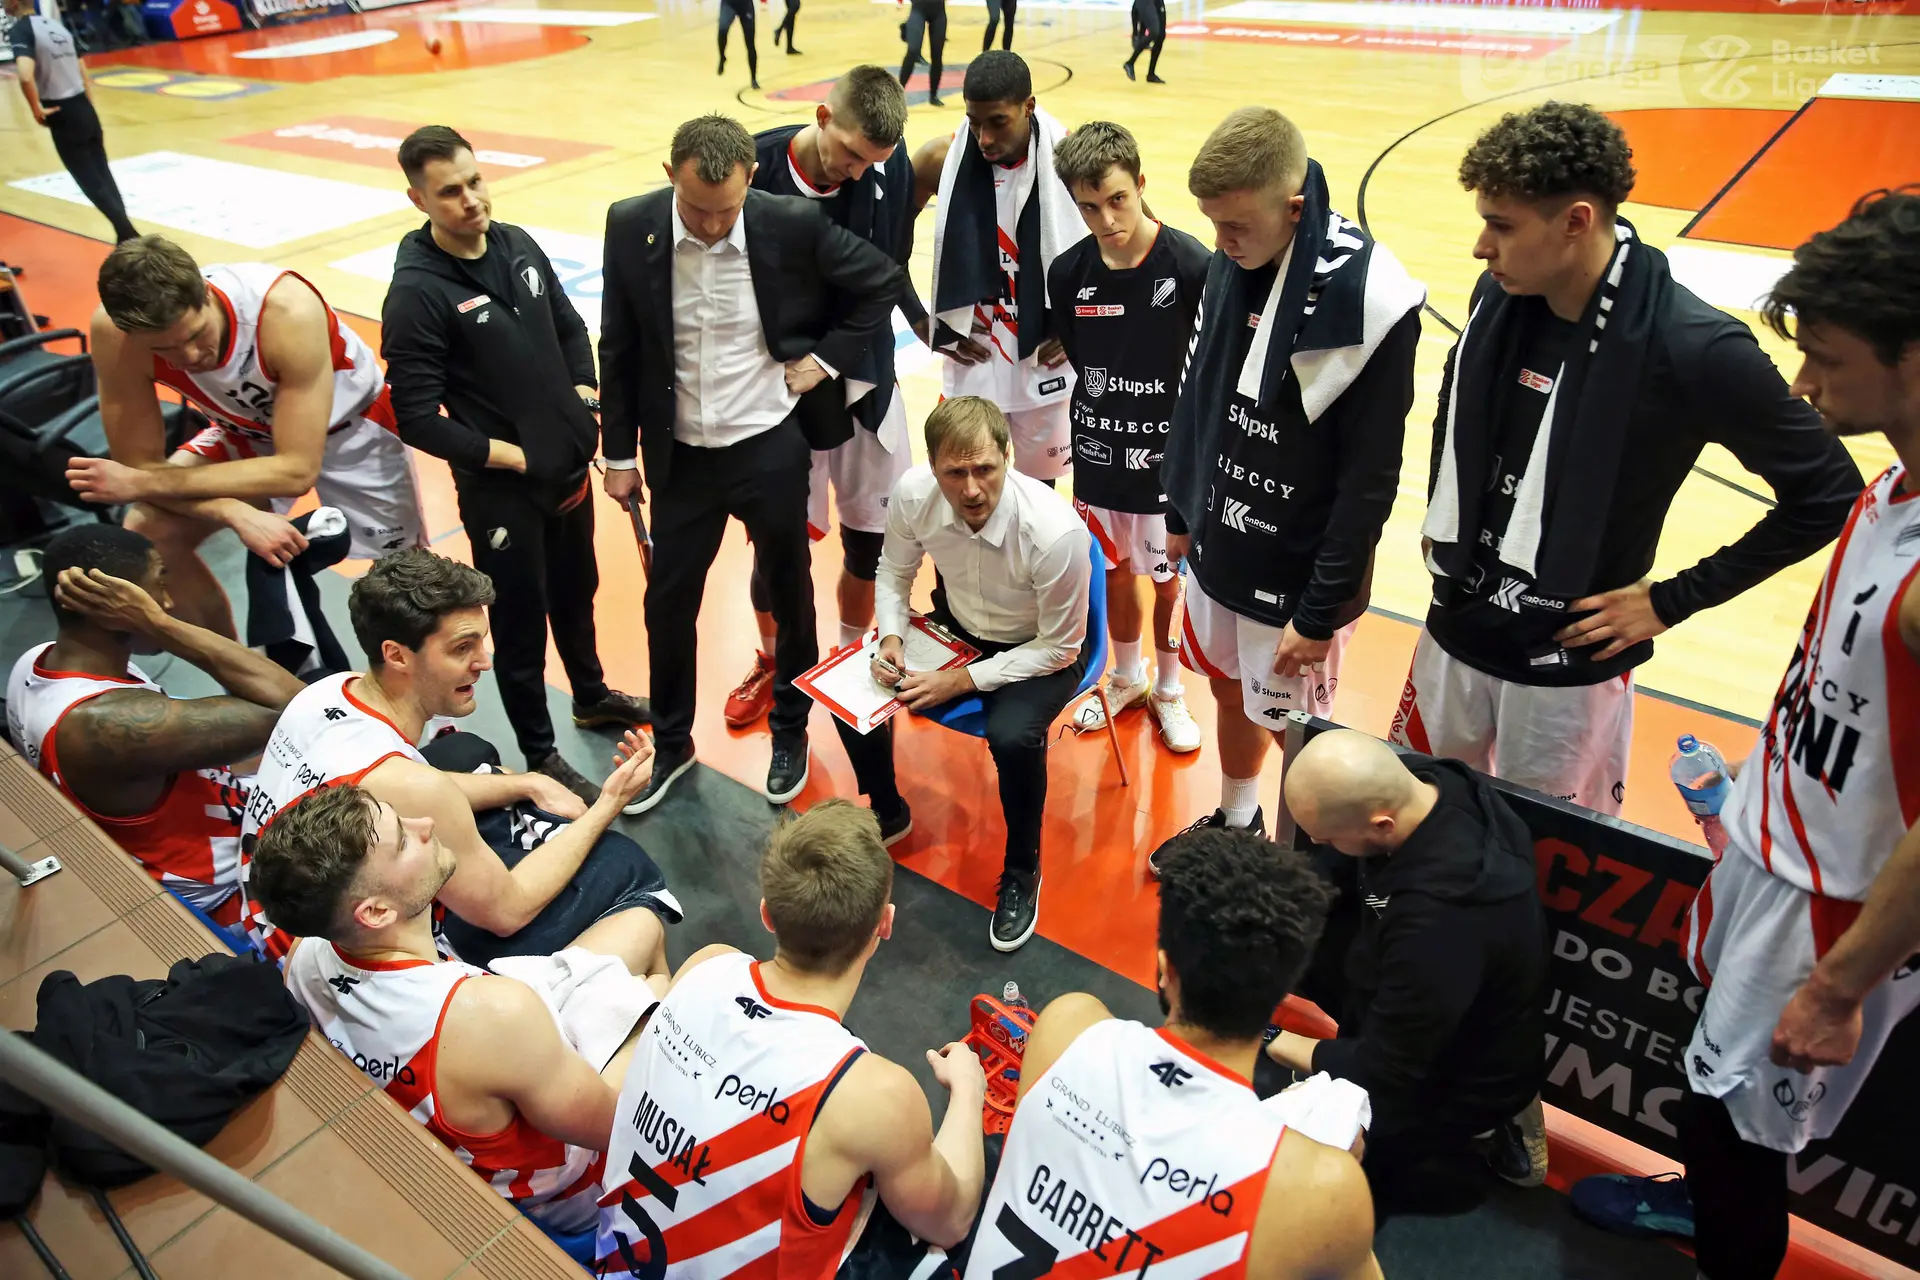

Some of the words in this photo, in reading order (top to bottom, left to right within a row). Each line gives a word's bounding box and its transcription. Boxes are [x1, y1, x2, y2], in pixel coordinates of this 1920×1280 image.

[1107, 376, 1166, 397] Słupsk
[1228, 403, 1280, 445] Słupsk
[1244, 515, 1278, 533] onROAD
[1519, 594, 1565, 610] onROAD
[1261, 687, 1292, 700] Słupsk
[1553, 929, 1633, 980] DO
[735, 996, 773, 1020] 4F
[661, 1006, 682, 1036] GRAND
[682, 1034, 717, 1069] LUBICZ
[1149, 1061, 1194, 1089] 4F
[714, 1074, 790, 1126] perla
[1050, 1076, 1091, 1112] GRAND
[1095, 1110, 1137, 1149] LUBICZ
[632, 1090, 712, 1188] MUSIAŁ
[1139, 1156, 1234, 1218] perla
[1026, 1164, 1164, 1280] GARRETT
